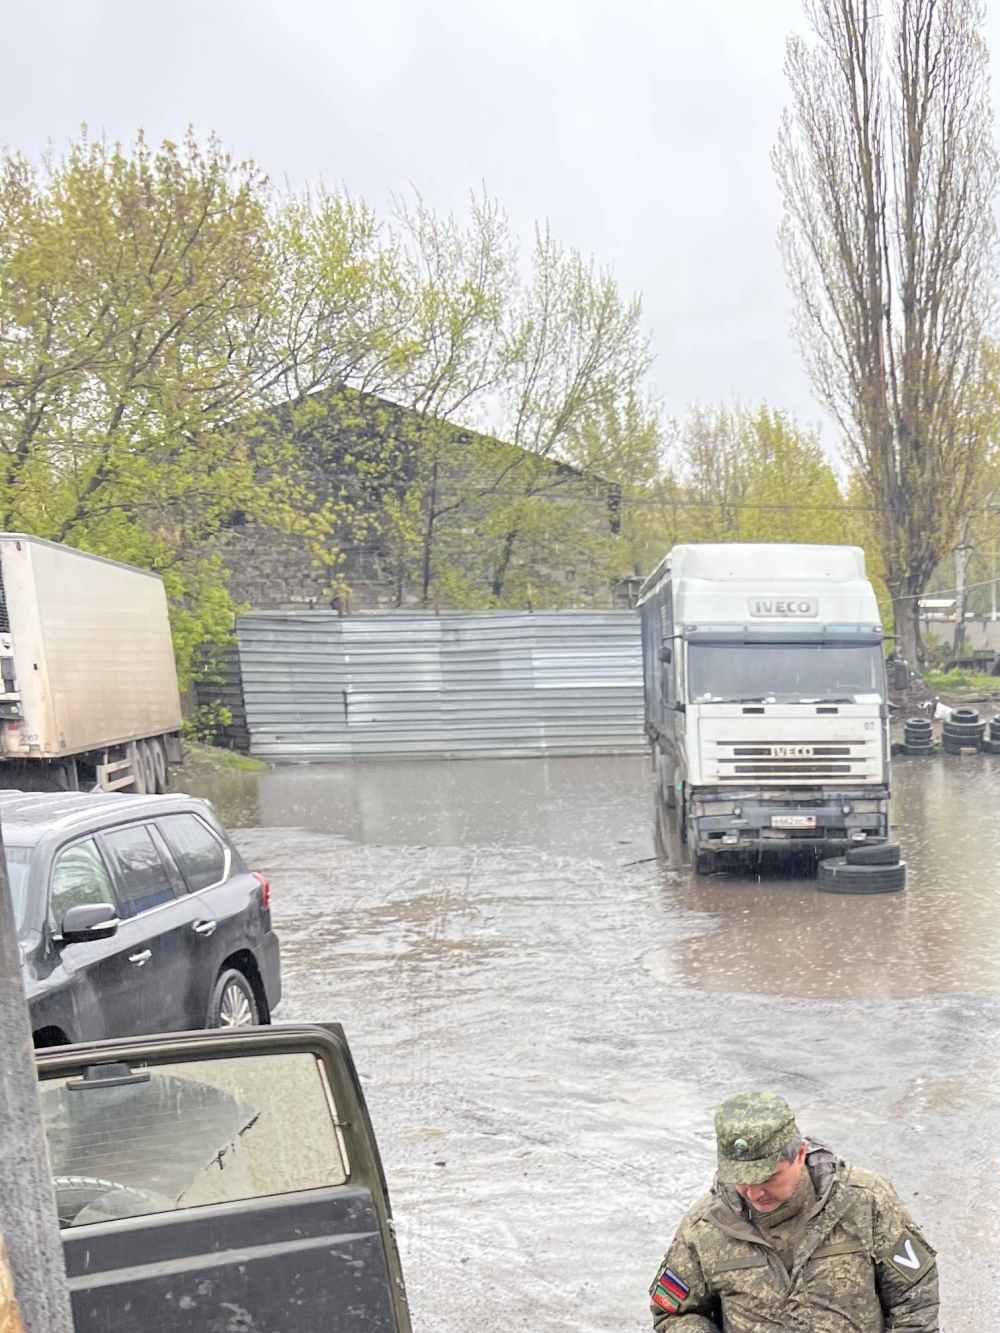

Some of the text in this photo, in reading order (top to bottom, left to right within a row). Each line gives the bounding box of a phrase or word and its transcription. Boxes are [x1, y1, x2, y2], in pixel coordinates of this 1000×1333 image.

[755, 601, 811, 613] IVECO
[770, 747, 814, 757] IVECO
[893, 1239, 921, 1270] V
